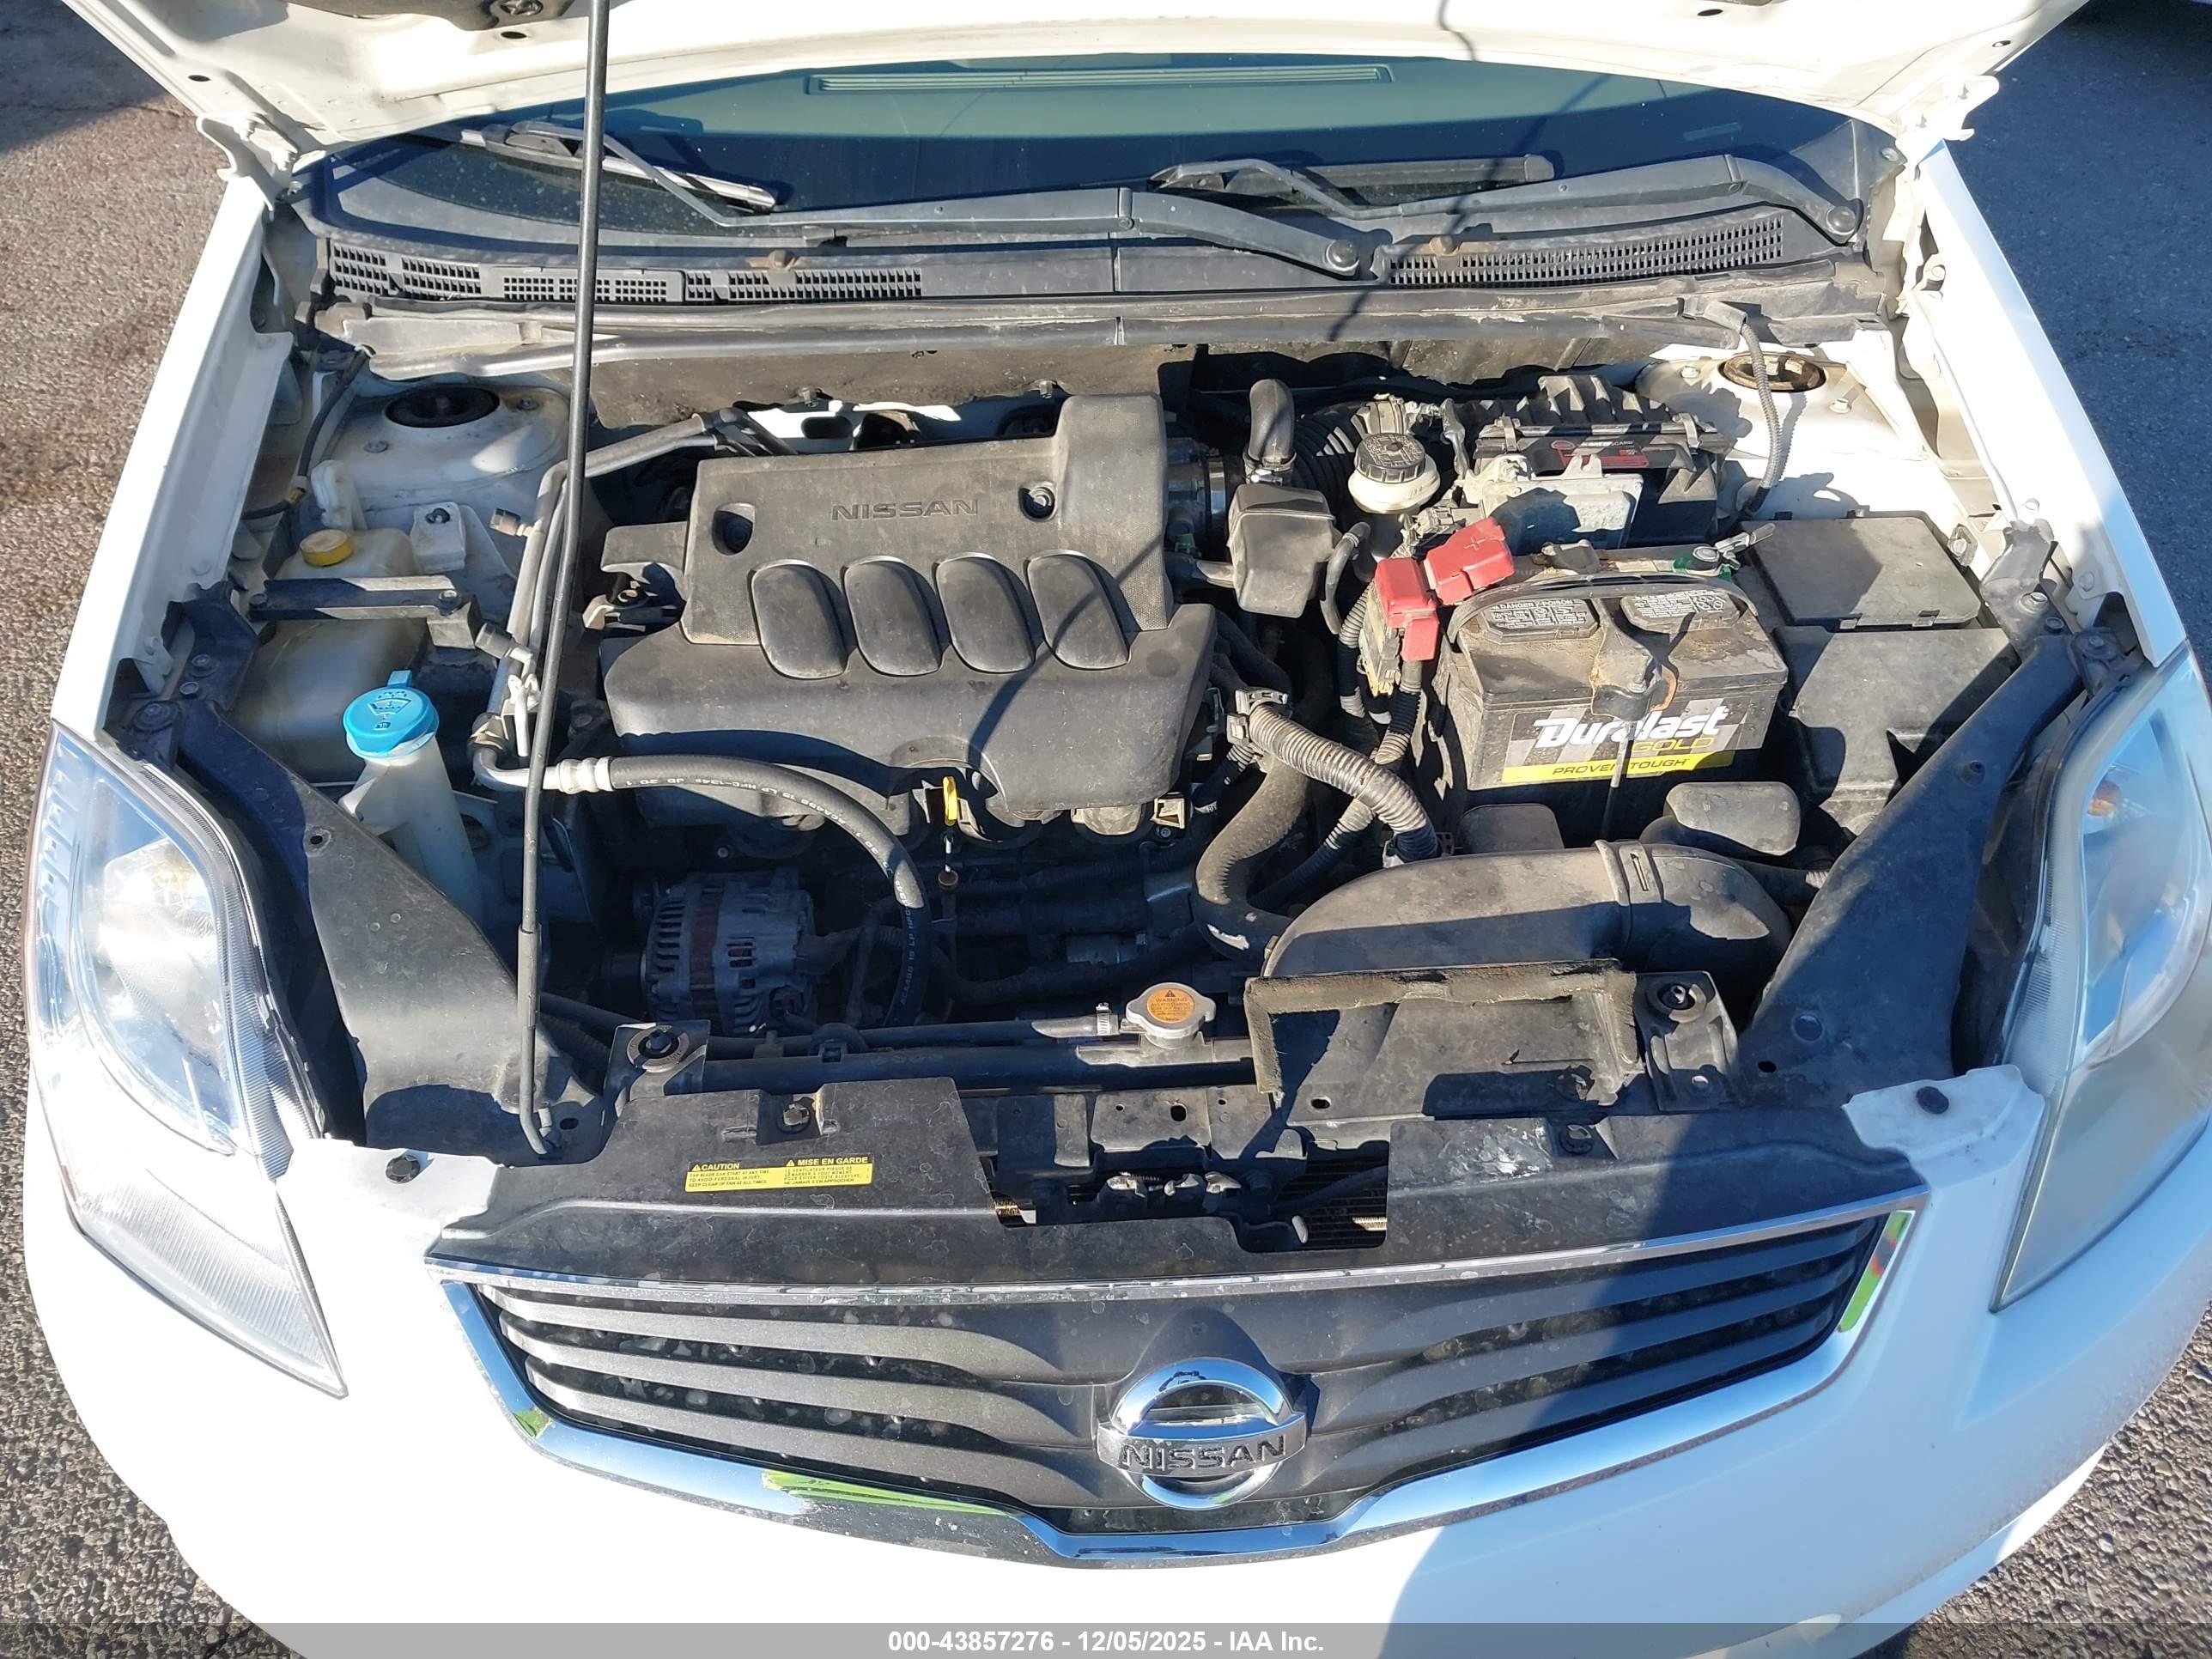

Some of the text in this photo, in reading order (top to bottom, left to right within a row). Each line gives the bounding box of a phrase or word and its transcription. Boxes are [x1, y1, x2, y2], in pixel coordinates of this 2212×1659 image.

[831, 499, 979, 521] NISSAN
[1632, 737, 1715, 753] GOLD
[1119, 1436, 1285, 1471] NISSAN
